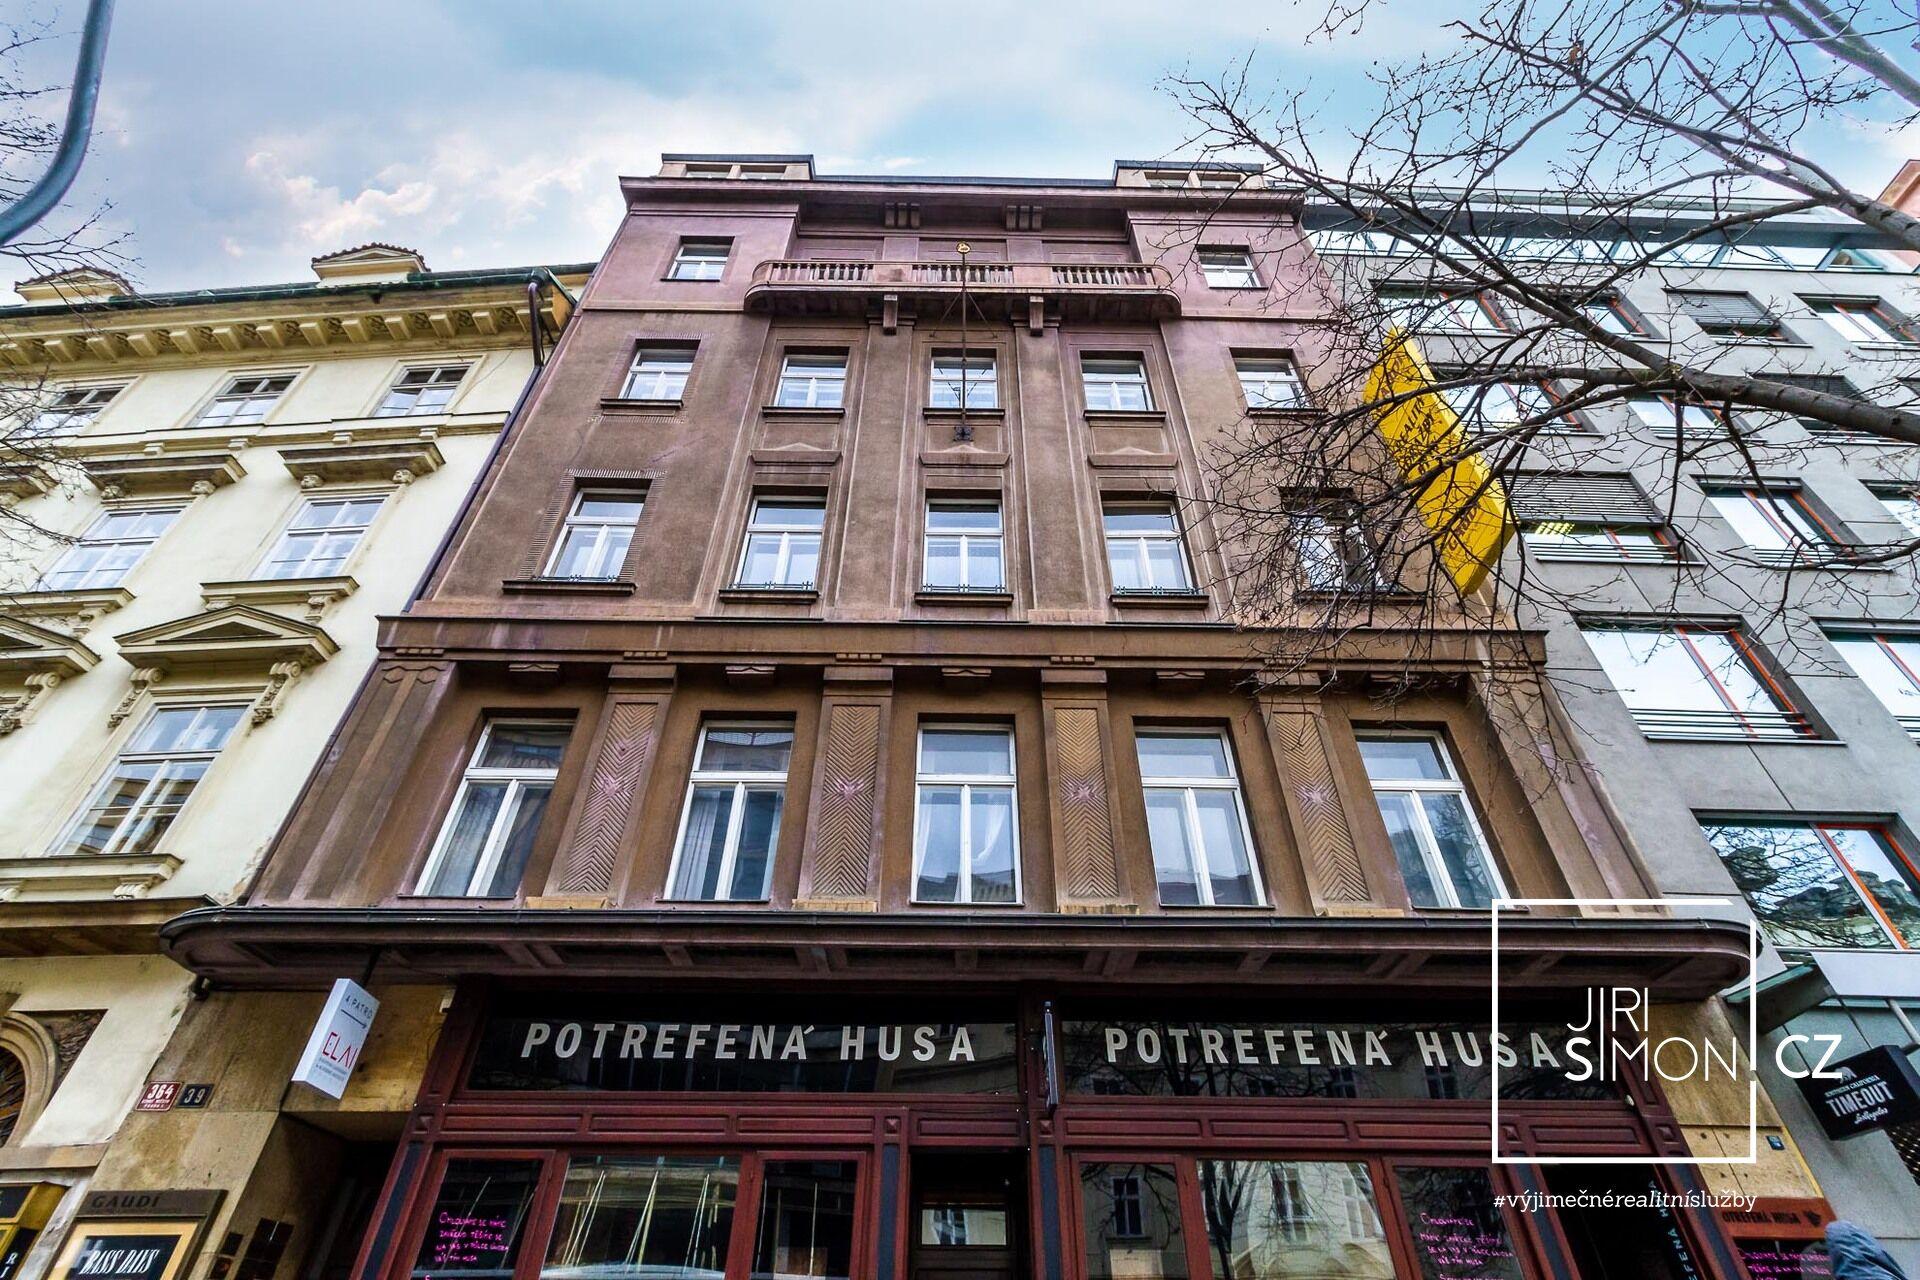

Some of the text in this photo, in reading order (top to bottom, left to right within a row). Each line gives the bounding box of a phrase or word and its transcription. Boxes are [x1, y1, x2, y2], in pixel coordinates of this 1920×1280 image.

[521, 1023, 975, 1062] POTREFENÁ HUSA
[1105, 1028, 1561, 1068] POTREFENÁ HUSA
[147, 1084, 174, 1099] 364
[183, 1088, 206, 1104] 39
[1825, 1081, 1895, 1117] TIMEOUT
[78, 1249, 161, 1275] BASS DAYS
